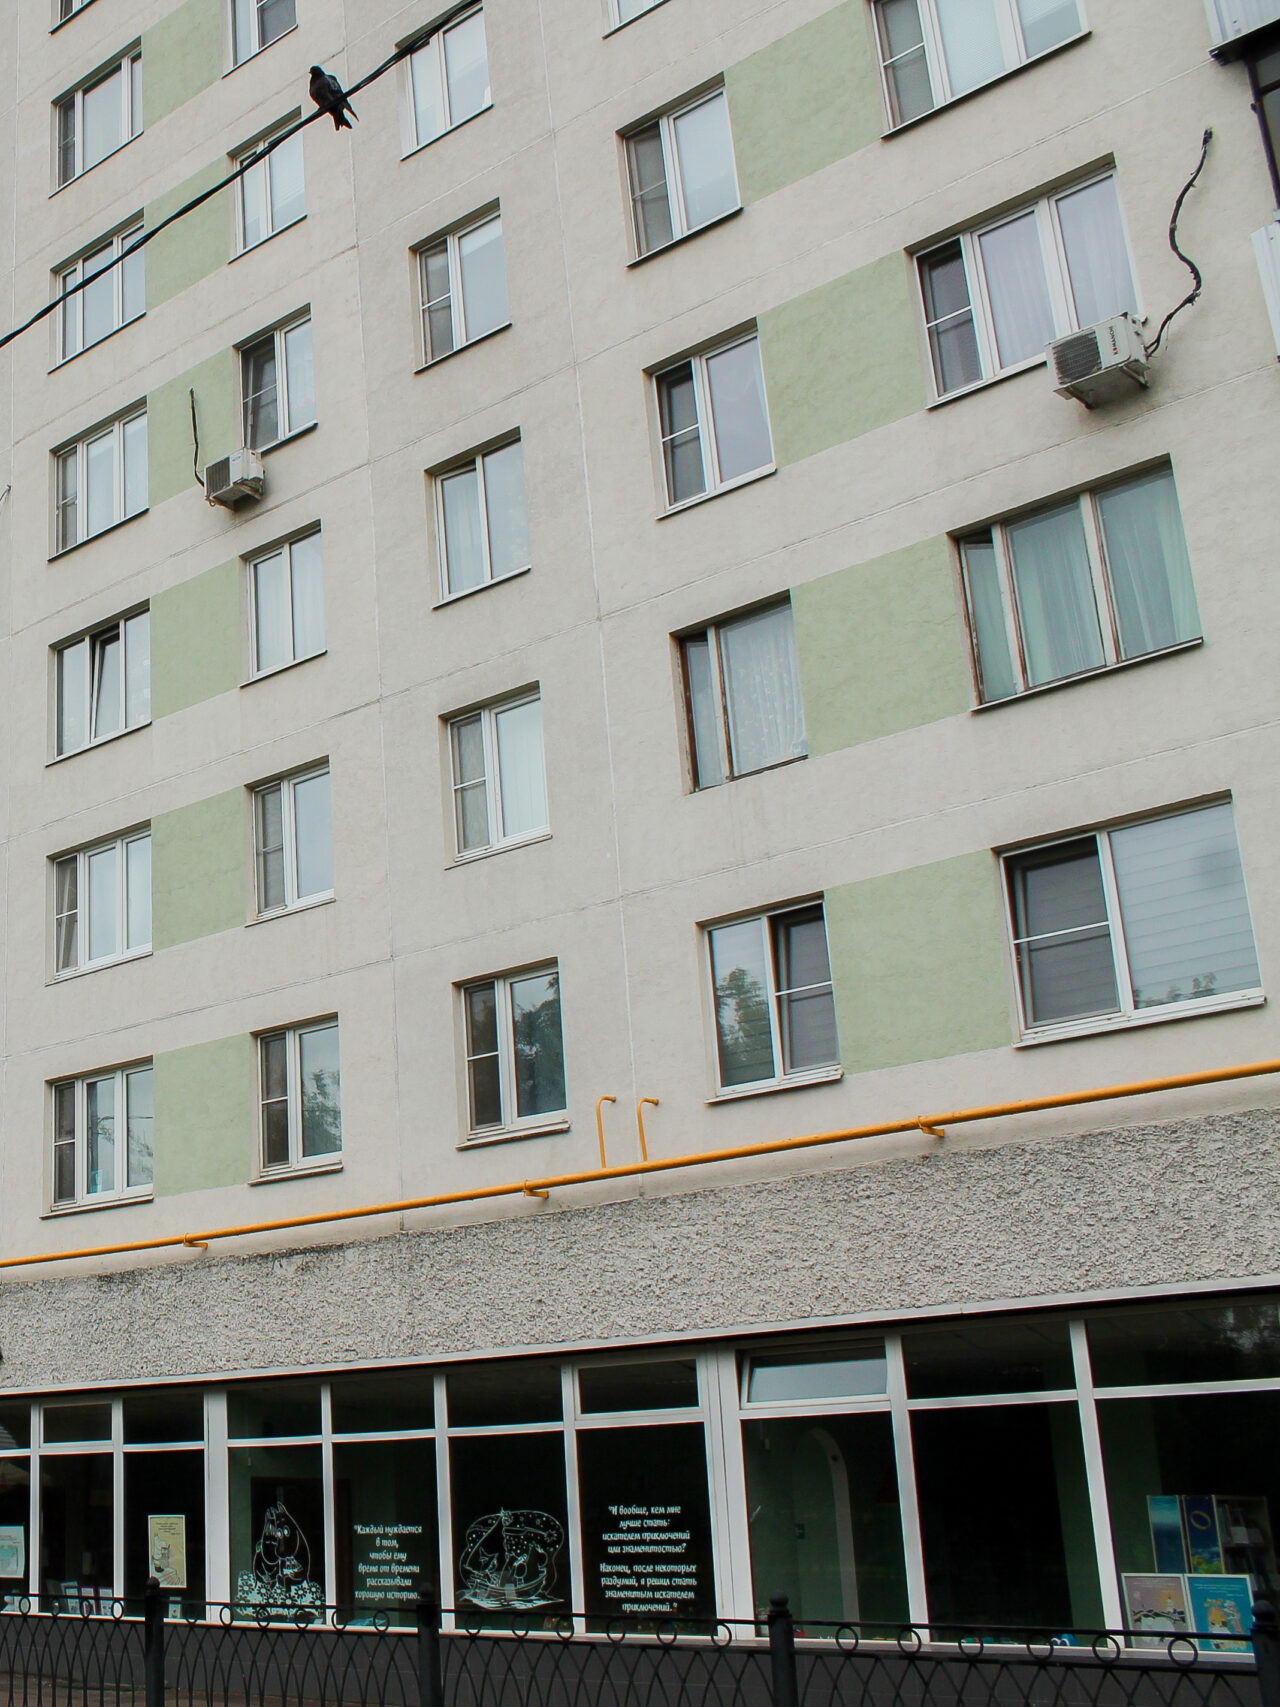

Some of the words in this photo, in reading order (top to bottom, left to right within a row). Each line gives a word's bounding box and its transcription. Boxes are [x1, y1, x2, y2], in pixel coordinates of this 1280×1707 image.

[619, 1504, 649, 1516] вообще,
[651, 1506, 665, 1514] кем
[667, 1505, 681, 1514] мне
[385, 1524, 422, 1536] нуждается
[619, 1519, 642, 1530] лучше
[602, 1532, 641, 1541] искателем
[642, 1530, 691, 1542] приключений
[376, 1537, 381, 1547] в
[382, 1539, 399, 1548] том,
[622, 1543, 687, 1553] знаменитостью?
[369, 1550, 392, 1560] чтобы
[393, 1551, 407, 1562] ему
[380, 1565, 390, 1573] от
[391, 1563, 420, 1575] времени
[600, 1562, 631, 1574] Наконец,
[633, 1565, 654, 1573] после
[655, 1564, 697, 1574] некоторых
[366, 1576, 412, 1587] рассказывали
[601, 1575, 638, 1588] раздумий,
[646, 1577, 670, 1588] решил
[671, 1577, 698, 1586] стать
[355, 1591, 385, 1601] хорошую
[605, 1590, 653, 1598] знаменитым
[654, 1590, 695, 1599] искателем
